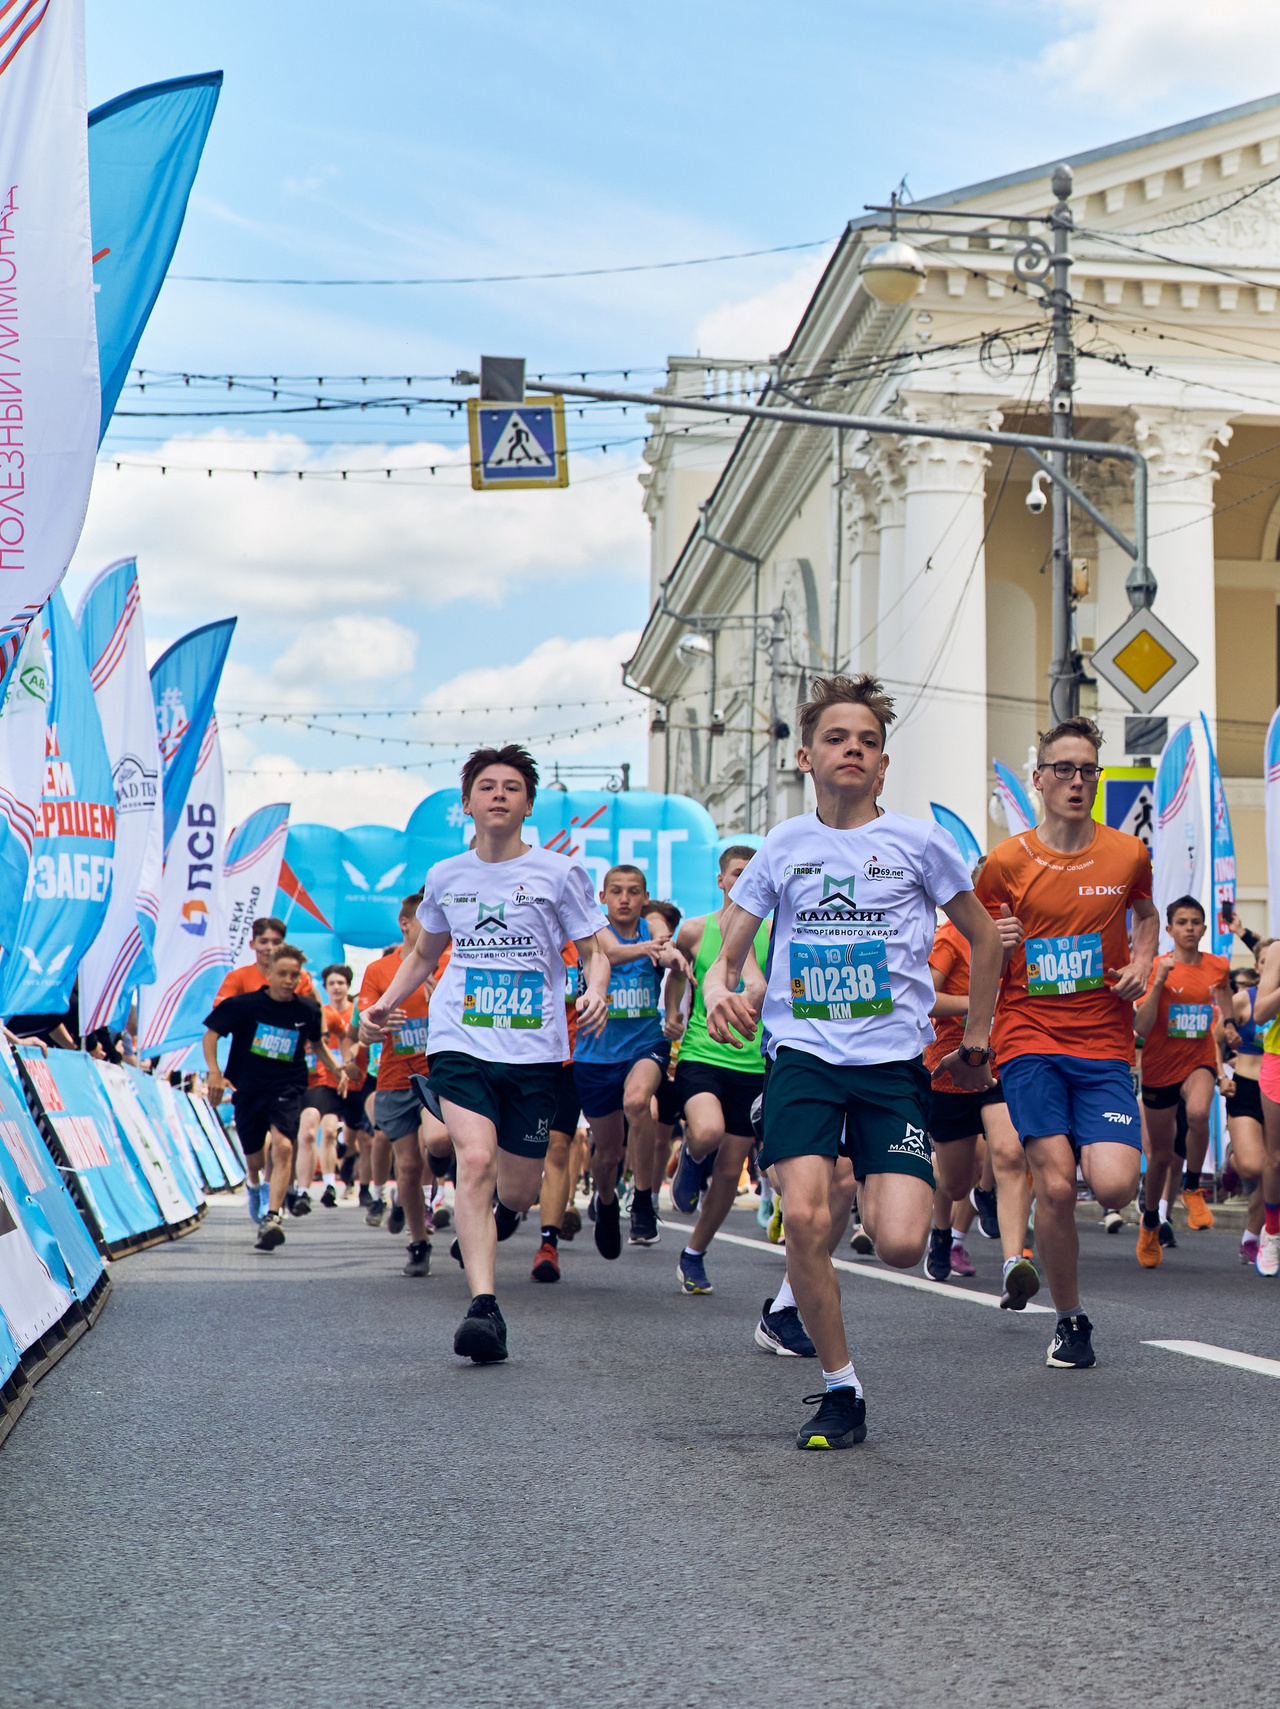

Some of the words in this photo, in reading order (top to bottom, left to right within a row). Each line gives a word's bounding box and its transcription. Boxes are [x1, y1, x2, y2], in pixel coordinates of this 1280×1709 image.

[35, 800, 116, 842] ЕРДЦЕМ
[187, 803, 216, 891] ПСБ
[793, 867, 822, 875] TRADE-IN
[868, 863, 904, 878] ip69.net
[1095, 885, 1127, 896] DKC
[796, 911, 886, 922] МАЛАХИТ
[456, 936, 533, 947] МАЛАХИТ
[866, 929, 899, 937] КАРАТЭ
[1037, 949, 1092, 981] 10497
[801, 964, 877, 1003] 10238
[474, 986, 533, 1015] 10242
[612, 988, 650, 1009] 10009
[1176, 1014, 1208, 1031] 10218
[400, 1028, 427, 1047] 1019
